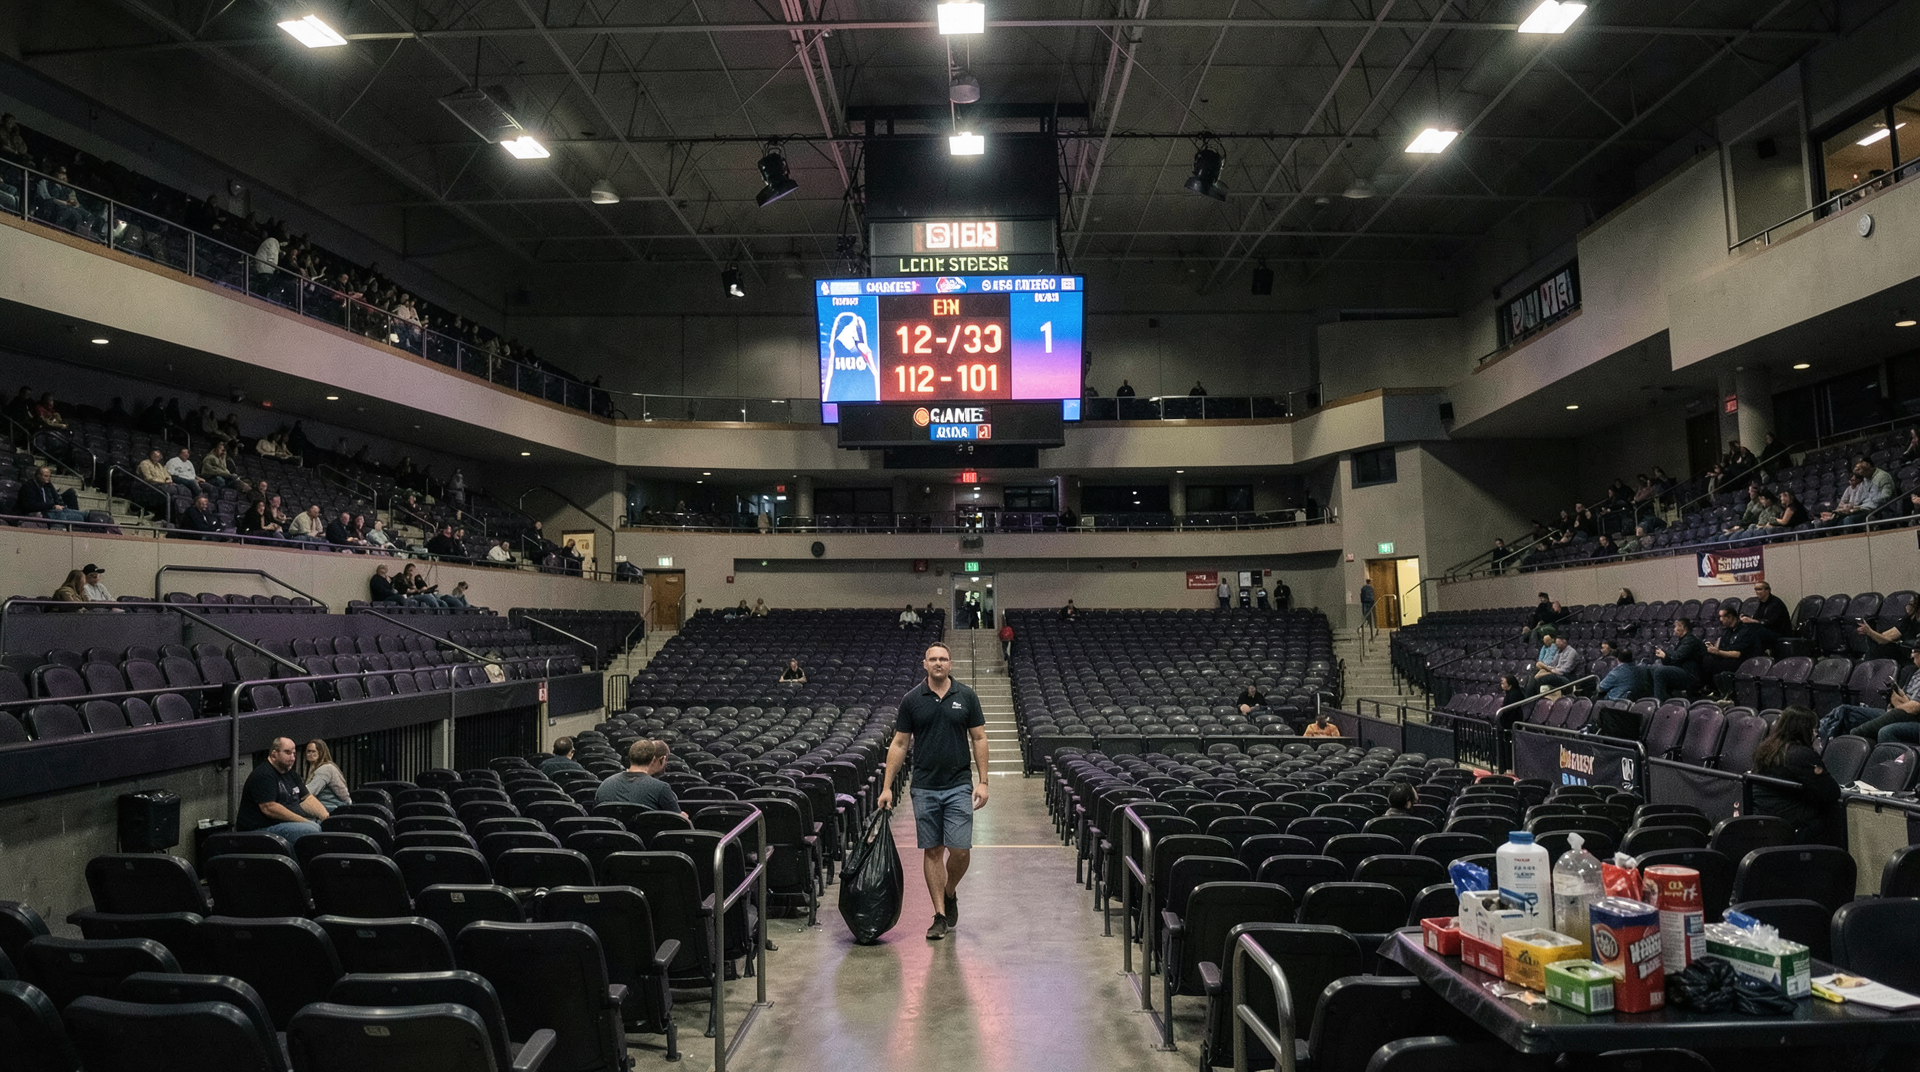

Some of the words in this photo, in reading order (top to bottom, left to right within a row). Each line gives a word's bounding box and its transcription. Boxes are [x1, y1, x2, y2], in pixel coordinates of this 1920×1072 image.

[1040, 320, 1053, 354] 1
[895, 365, 935, 393] 112
[956, 364, 998, 392] 101
